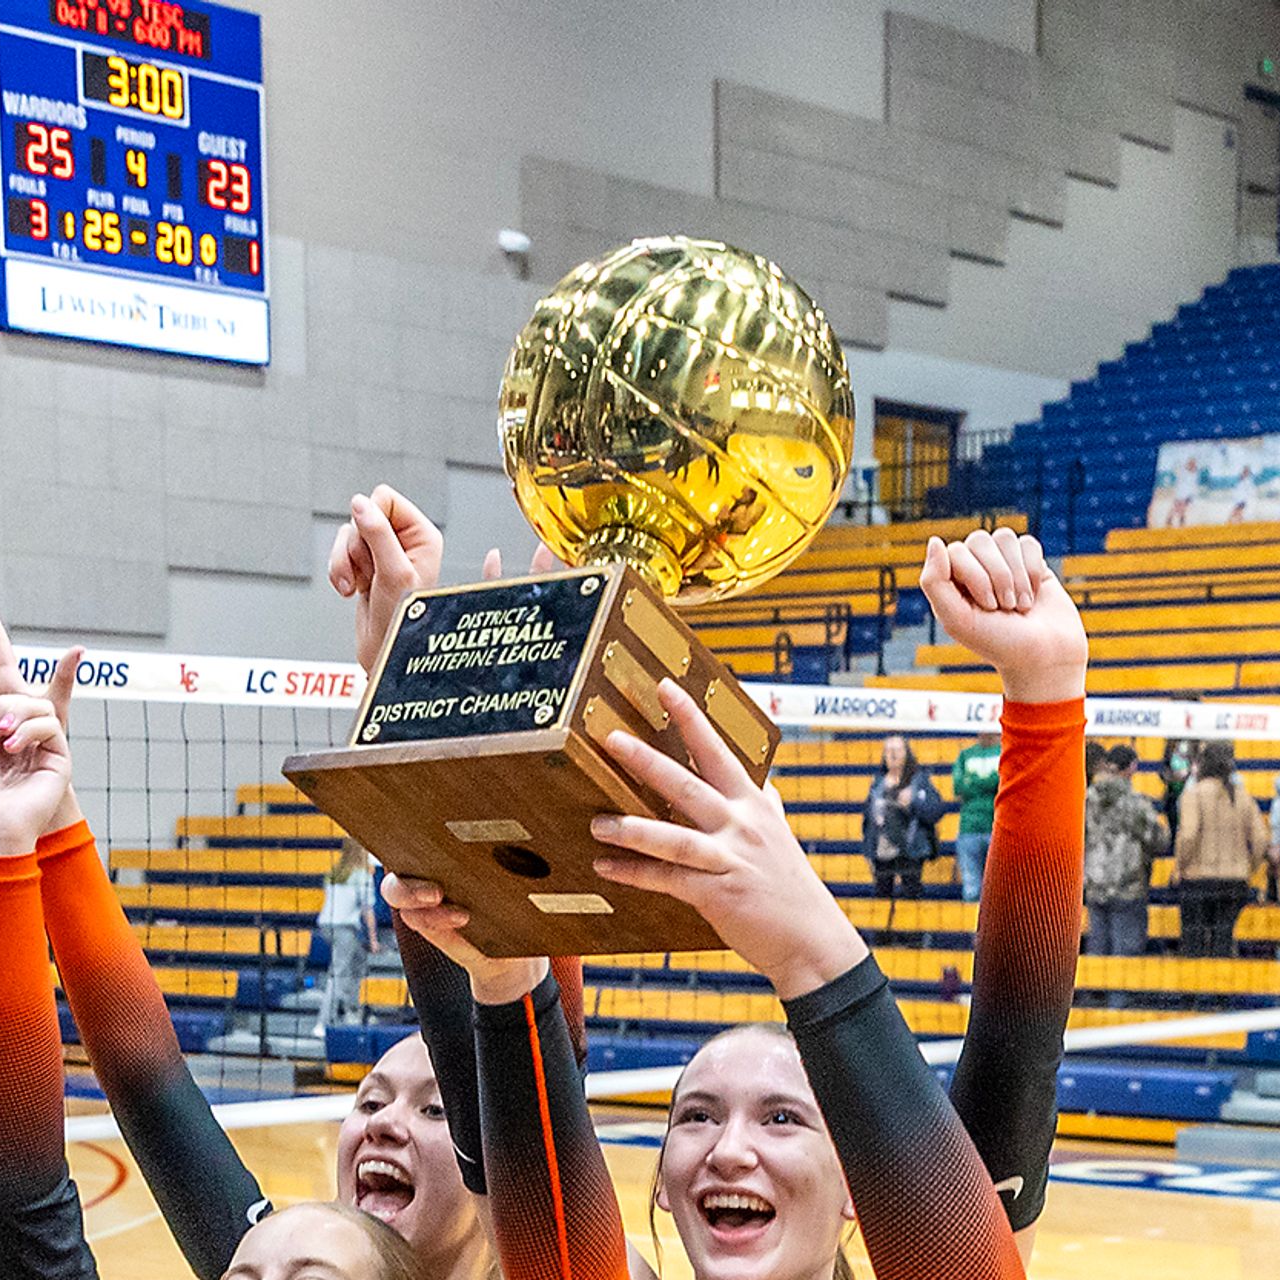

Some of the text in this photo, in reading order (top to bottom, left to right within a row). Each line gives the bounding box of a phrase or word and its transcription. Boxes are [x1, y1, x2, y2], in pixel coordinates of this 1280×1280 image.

[178, 28, 202, 57] PM
[107, 55, 183, 119] 3:00
[3, 90, 87, 130] WARRIORS
[24, 122, 74, 181] 25
[197, 131, 247, 162] GUEST
[126, 149, 147, 187] 4
[207, 159, 251, 213] 23
[29, 198, 49, 241] 3
[83, 208, 123, 255] 25
[155, 220, 193, 267] 20
[248, 239, 261, 276] 1
[40, 286, 237, 337] LEWISTON TRIBUNE
[457, 606, 523, 630] DISTRICT
[427, 620, 554, 654] VOLLEYBALL
[405, 639, 568, 675] WHITEPINE LEAGUE
[245, 668, 277, 694] LC
[284, 671, 356, 697] STATE
[371, 687, 568, 724] DISTRICT CHAMPION
[814, 696, 897, 719] WARRIORS
[967, 703, 985, 721] LC
[1094, 709, 1161, 728] WARRIORS
